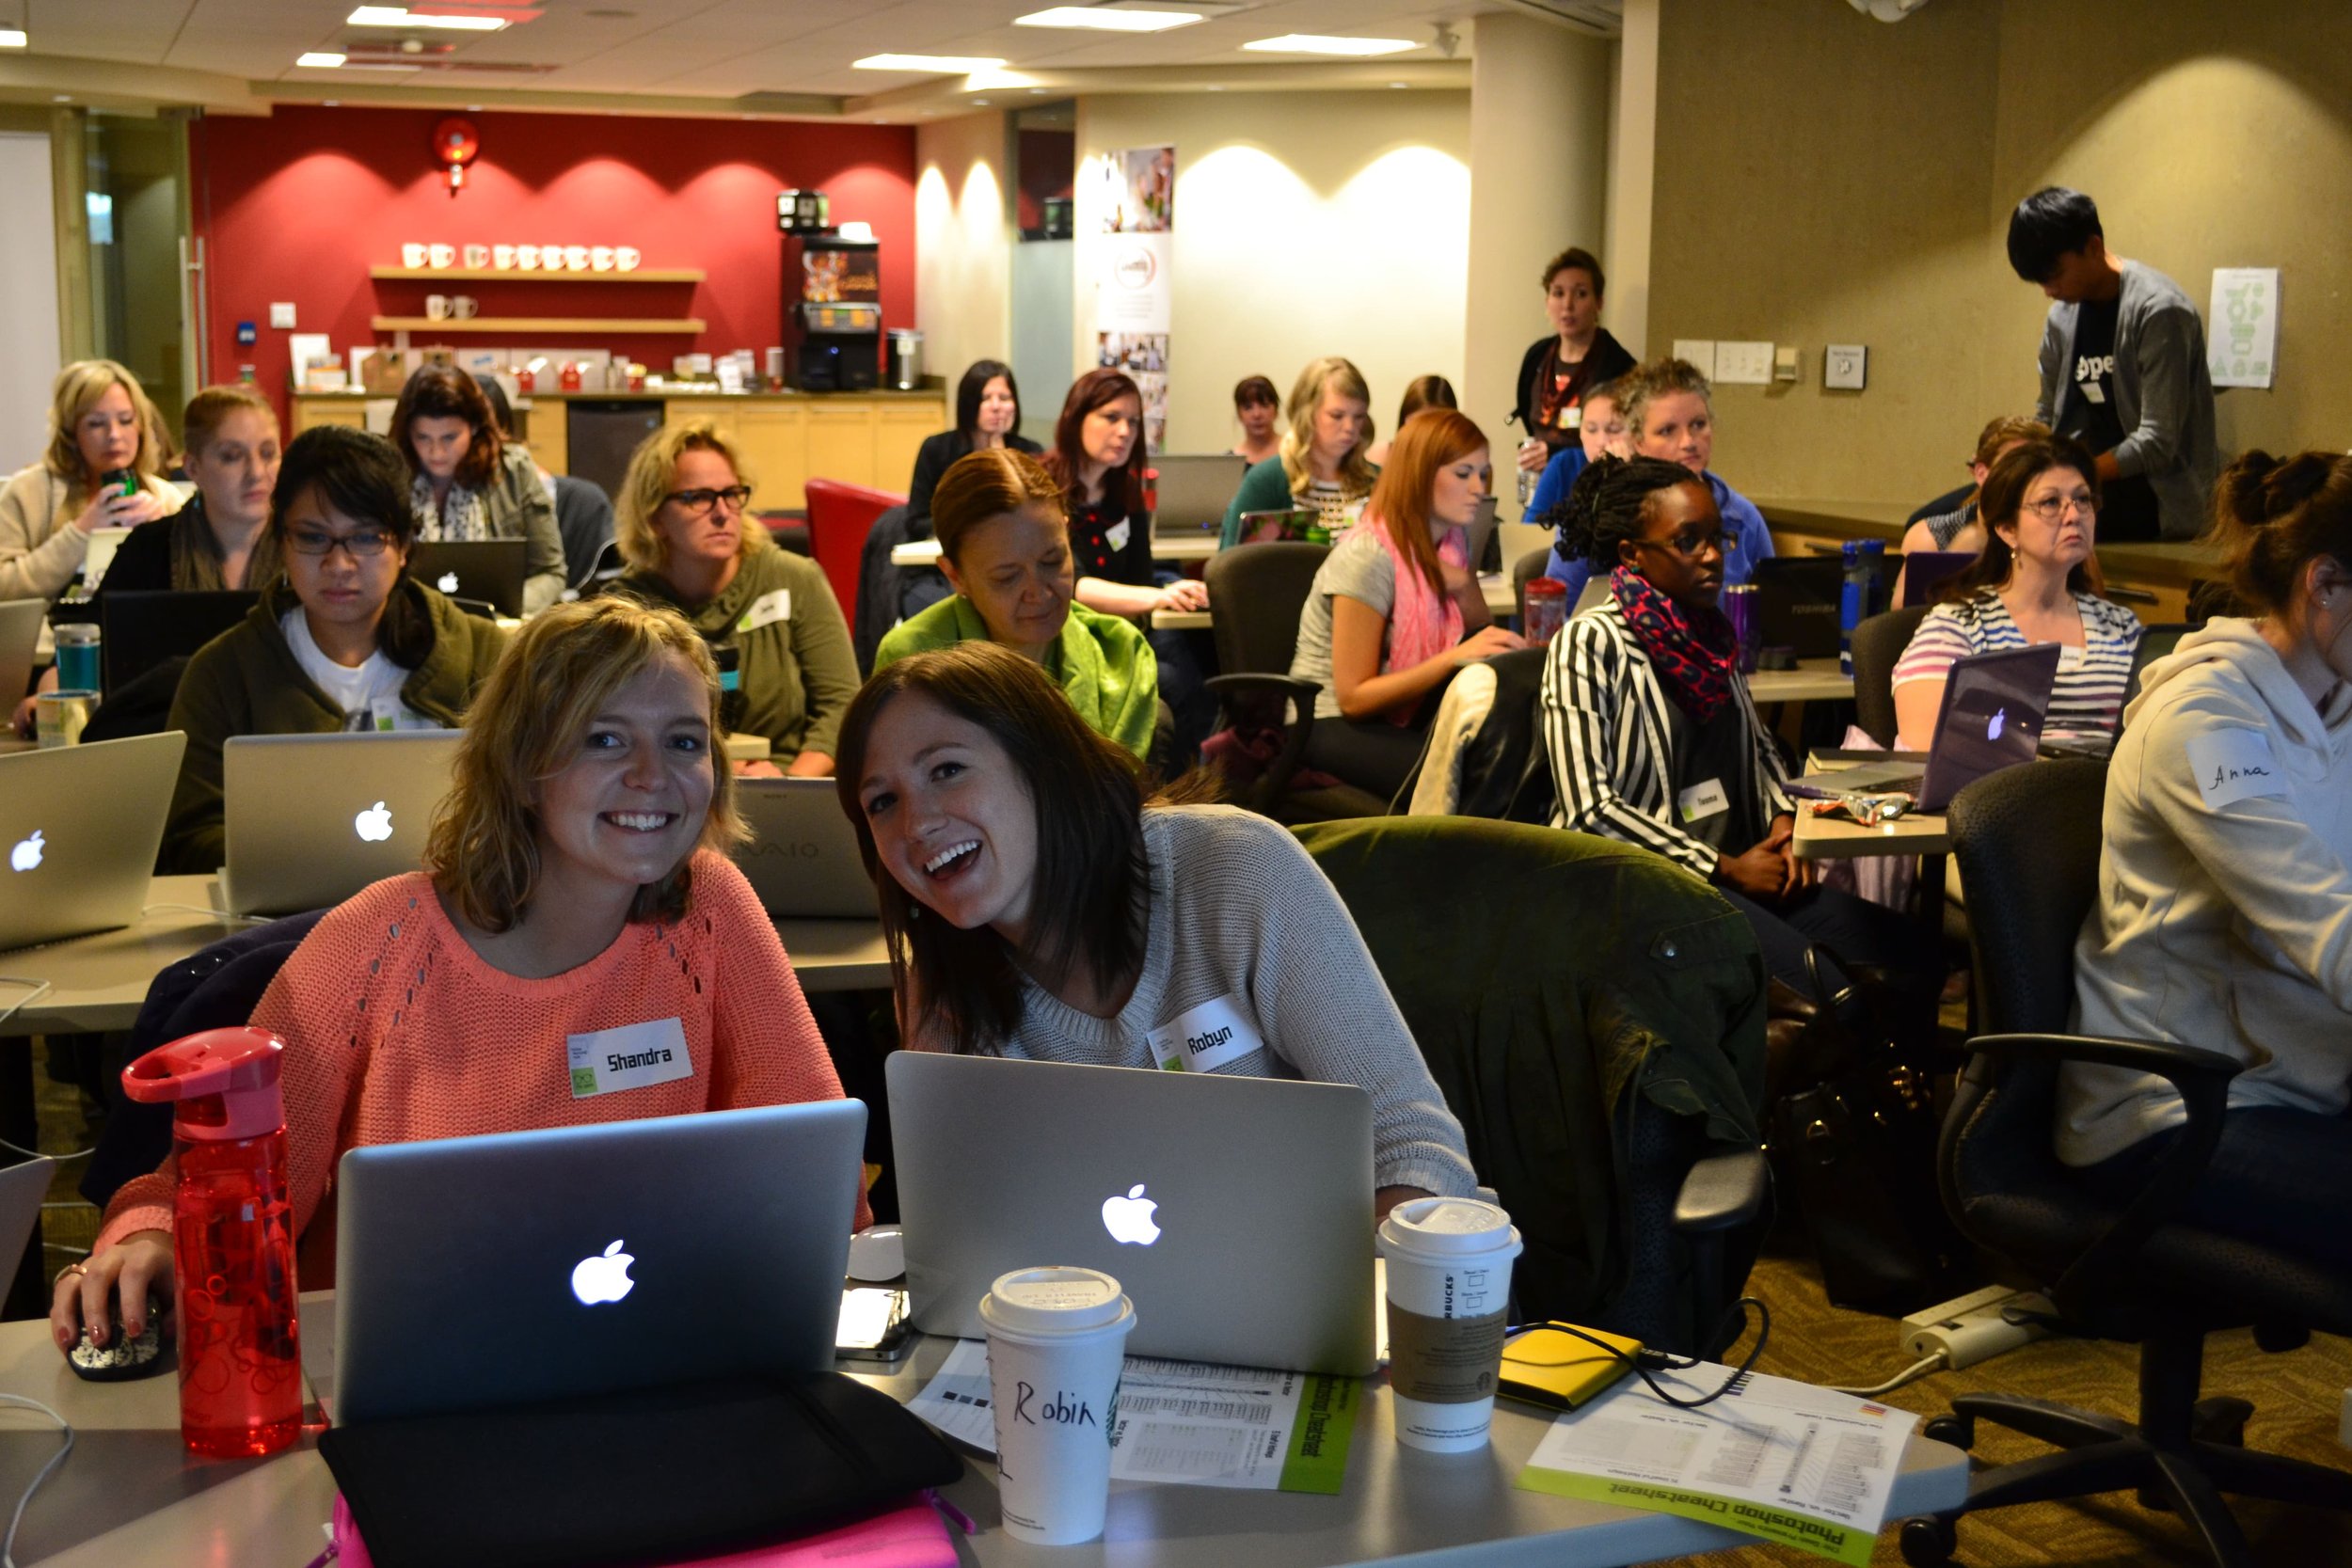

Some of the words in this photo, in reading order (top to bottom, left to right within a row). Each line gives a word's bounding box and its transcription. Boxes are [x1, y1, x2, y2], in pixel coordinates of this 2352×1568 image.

[2208, 765, 2270, 790] Anna
[1186, 1026, 1233, 1055] Robyn
[607, 1048, 673, 1072] Shandra
[1444, 1275, 1454, 1319] RBUCKS
[1013, 1380, 1097, 1427] Robin
[1608, 1483, 1728, 1513] Cheatsheet
[1734, 1504, 1846, 1546] Photoshop
